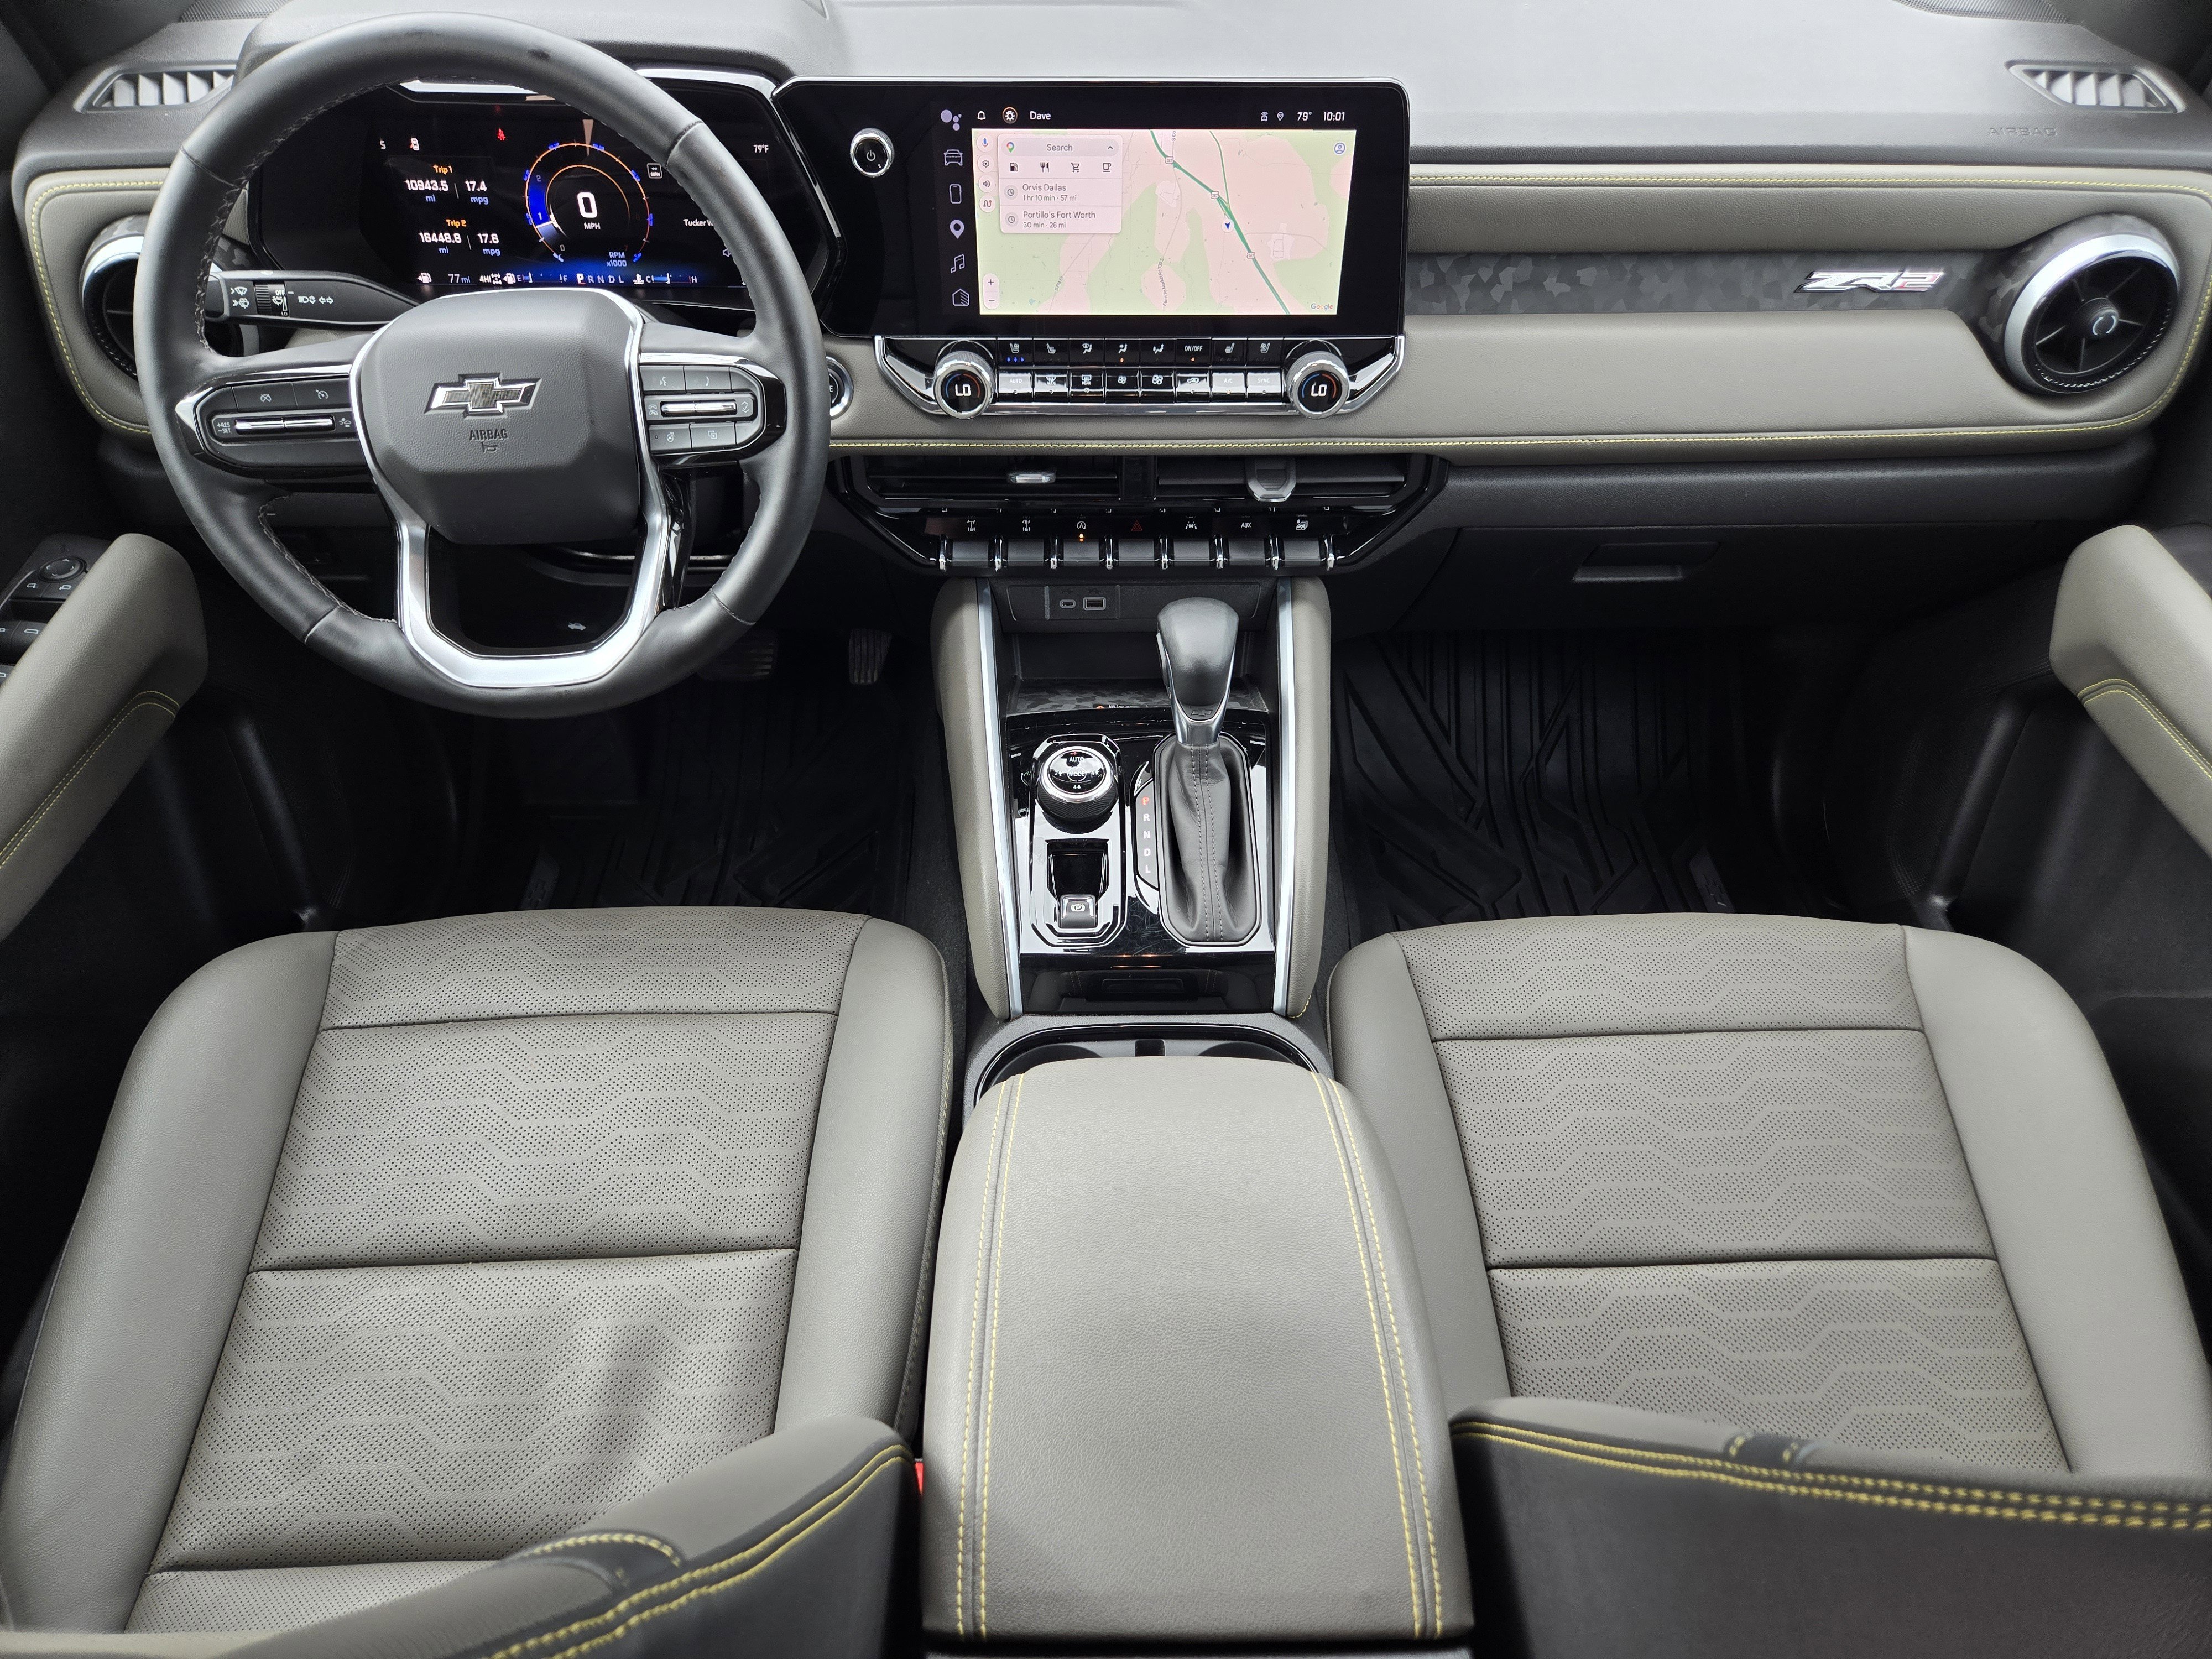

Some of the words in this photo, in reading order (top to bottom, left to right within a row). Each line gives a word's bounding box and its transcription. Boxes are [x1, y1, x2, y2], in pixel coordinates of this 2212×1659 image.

[1030, 111, 1051, 120] Dave
[1297, 112, 1312, 121] 79°
[1323, 112, 1345, 121] 10:01
[1990, 127, 2057, 136] AIRBAG
[753, 144, 769, 153] 79°F
[433, 165, 448, 175] Trip
[405, 179, 449, 191] 10943.5
[465, 180, 487, 191] 17.4
[470, 196, 489, 205] mpg
[577, 192, 598, 218] 0
[538, 212, 542, 220] 1
[446, 219, 461, 228] Trip
[483, 248, 500, 257] mpg
[448, 274, 460, 283] 77
[479, 275, 491, 283] 4HI
[576, 273, 585, 283] P
[588, 275, 594, 284] R
[597, 275, 604, 284] N
[608, 275, 615, 284] D
[619, 275, 624, 284] L
[1794, 271, 1945, 293] ZR2
[469, 428, 509, 441] AIRBAG
[1142, 796, 1149, 805] P
[1143, 813, 1150, 822] R
[1143, 831, 1151, 839] N
[1144, 848, 1151, 857] D
[1145, 865, 1151, 874] L
